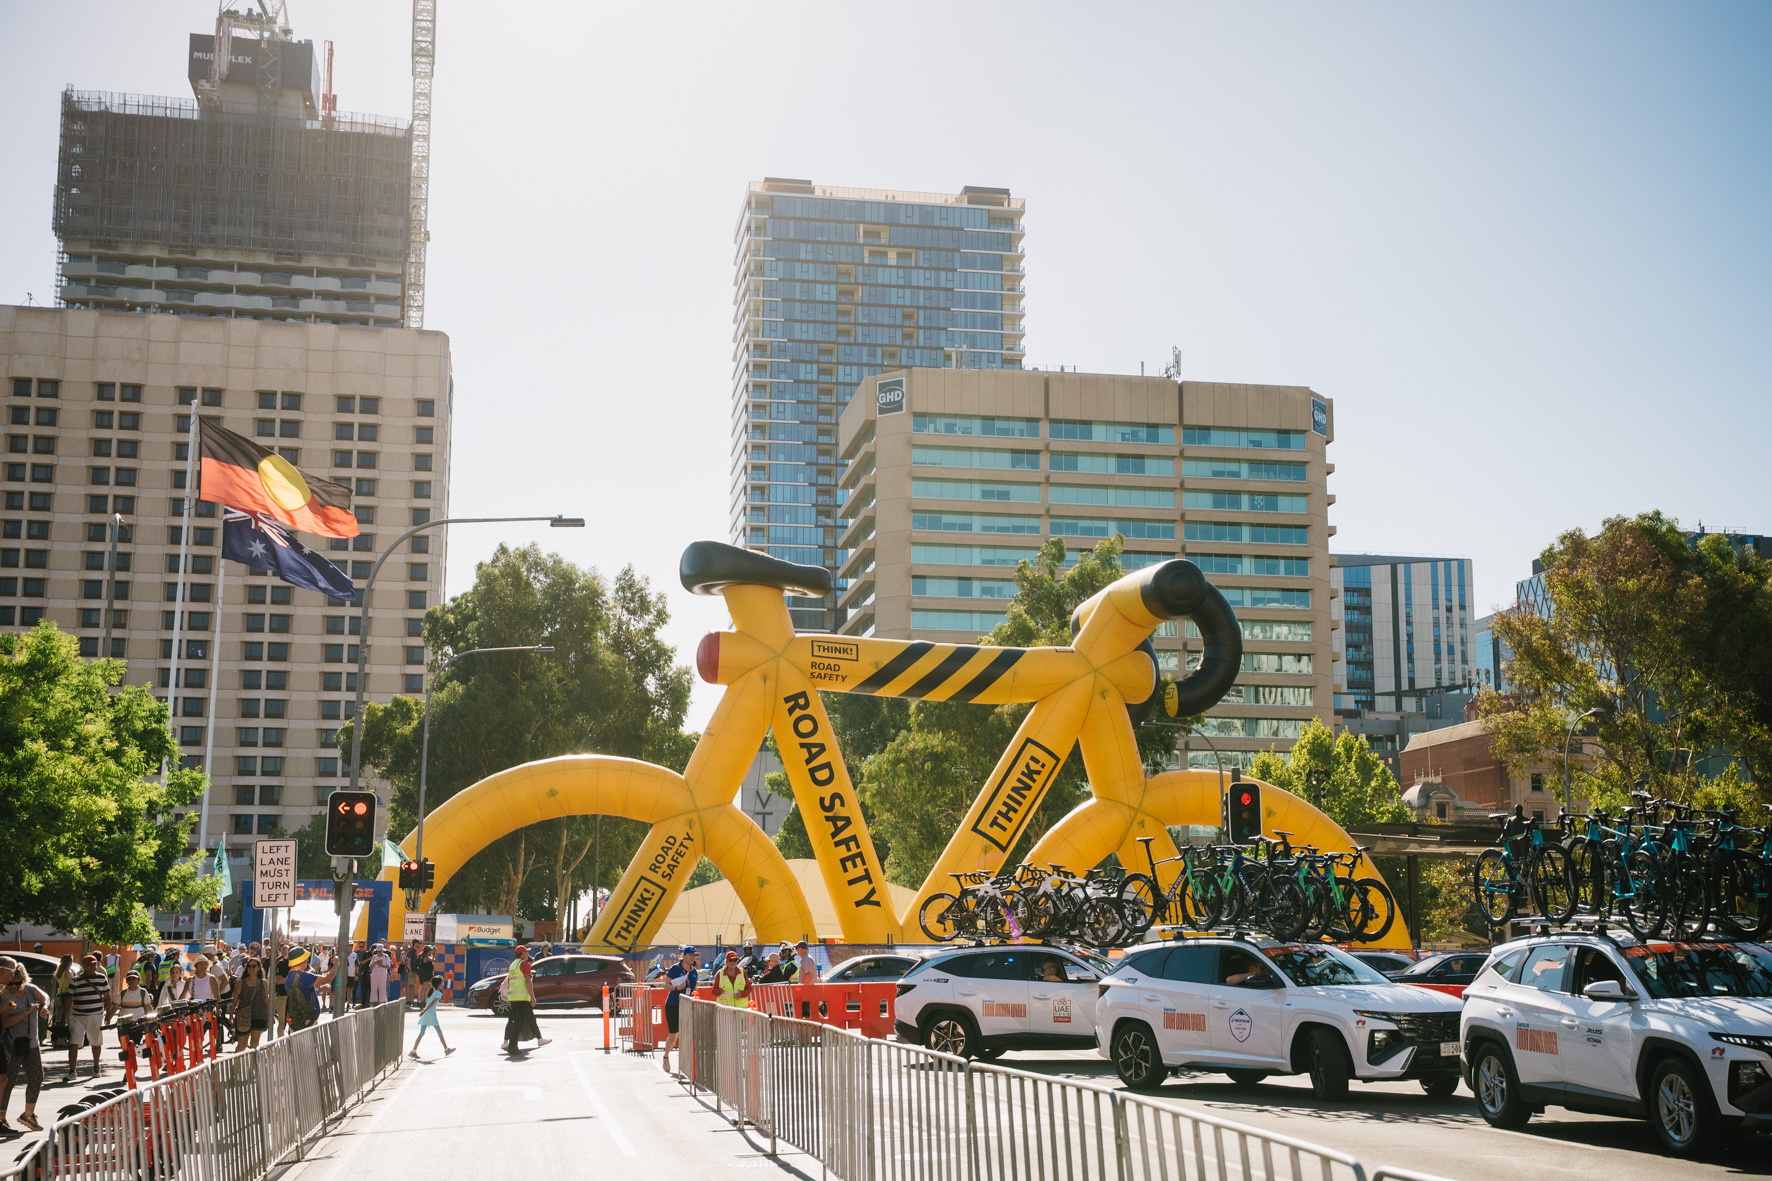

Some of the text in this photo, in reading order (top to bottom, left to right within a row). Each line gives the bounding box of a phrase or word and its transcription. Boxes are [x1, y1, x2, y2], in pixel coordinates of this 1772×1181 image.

[193, 51, 252, 64] MULLEX
[878, 390, 903, 404] GHD
[1313, 410, 1327, 424] GHD
[816, 644, 853, 655] THINK!
[810, 661, 841, 672] ROAD
[809, 671, 848, 682] SAFETY
[783, 690, 882, 909] ROAD SAFETY
[988, 755, 1047, 832] THINK!
[262, 845, 290, 854] LEFT
[648, 834, 677, 875] ROAD
[260, 857, 291, 866] LANE
[661, 832, 695, 881] SAFETY
[260, 869, 290, 878] MUST
[260, 881, 290, 890] TURN
[260, 893, 289, 902] LEFT
[308, 888, 374, 898] VILGE
[614, 887, 656, 941] THINK!
[405, 928, 423, 936] LANE
[477, 926, 501, 934] Budget
[982, 1003, 1027, 1018] TOUR DOWN UNDER
[1163, 1012, 1175, 1030] TOUR
[1176, 1012, 1191, 1031] DOWN
[1516, 1027, 1529, 1051] TOUR
